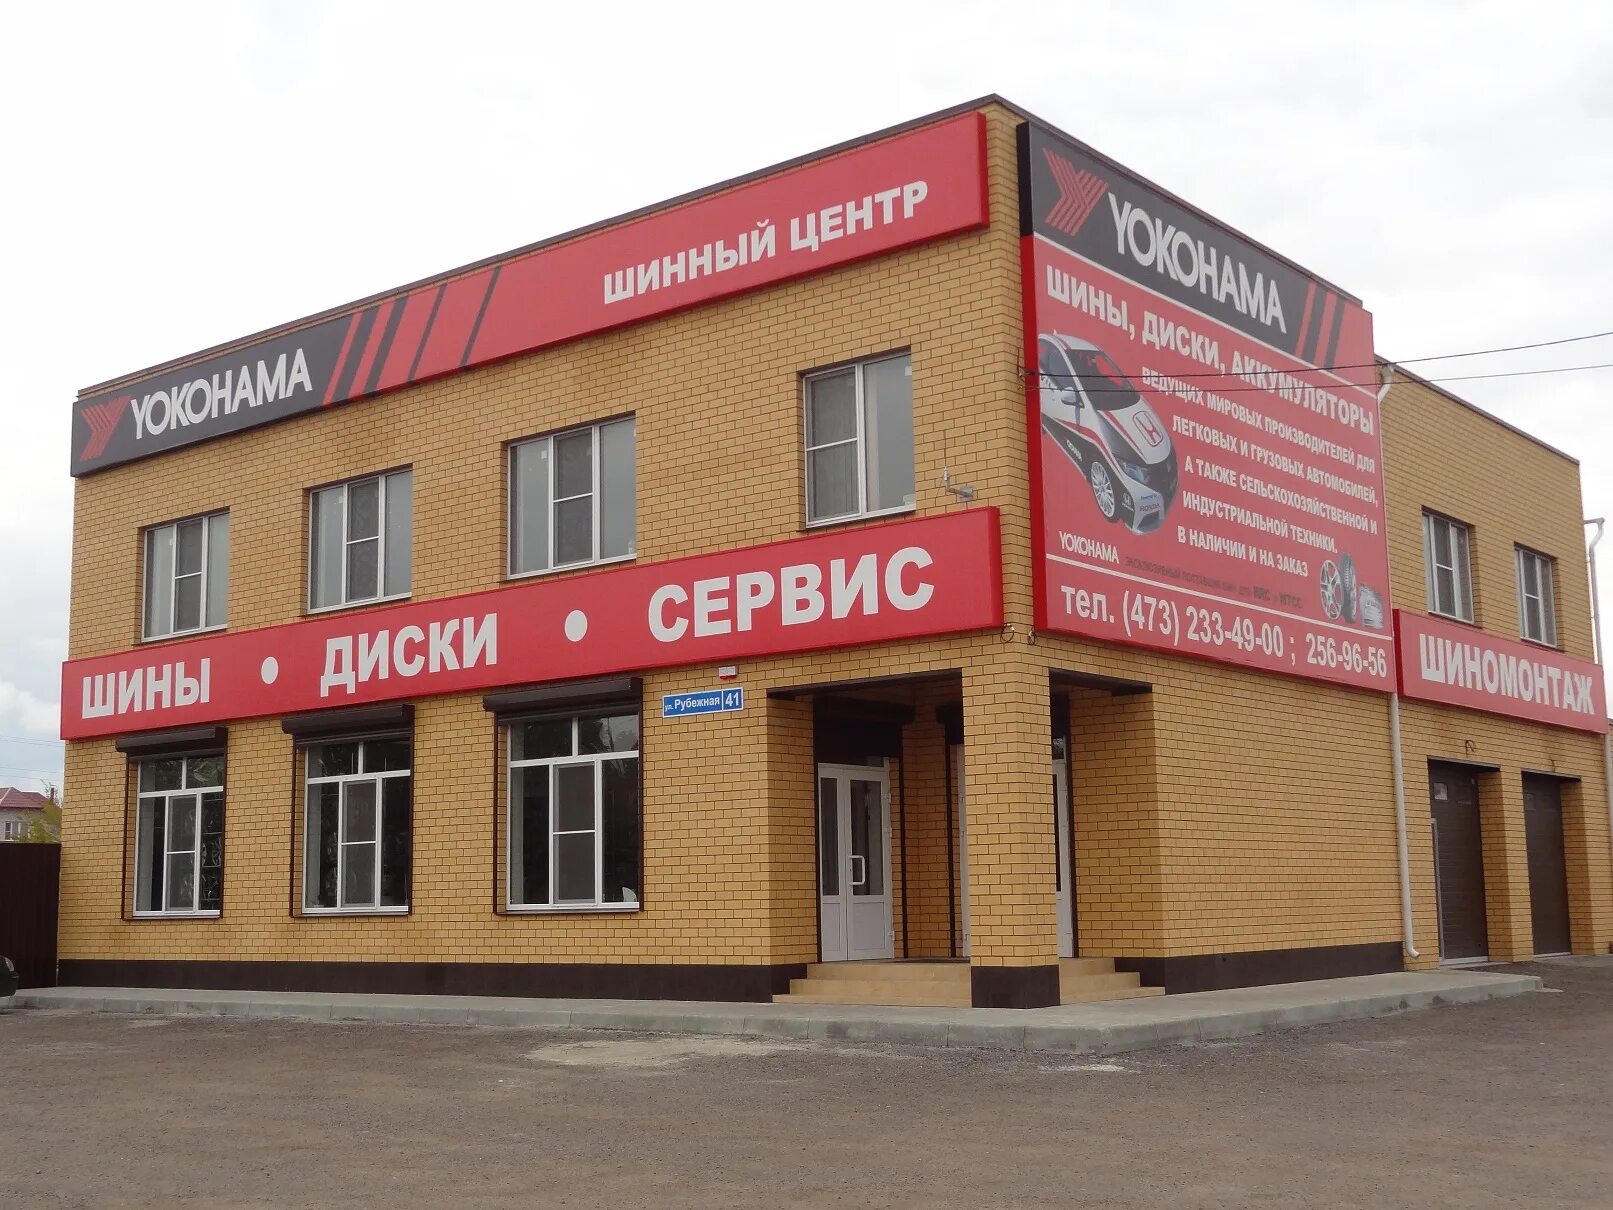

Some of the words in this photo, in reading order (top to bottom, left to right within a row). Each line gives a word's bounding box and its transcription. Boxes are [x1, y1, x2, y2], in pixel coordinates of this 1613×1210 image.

[604, 218, 776, 304] ШИННЫЙ
[790, 180, 929, 252] ЦЕНТР
[1107, 192, 1287, 334] YOKOHAMA
[130, 348, 313, 440] YOKOHAMA
[1046, 264, 1136, 341] ШИНЫ,
[1142, 310, 1226, 374] ДИСКИ,
[1231, 351, 1375, 436] АККУМУЛЯТОРЫ
[1142, 366, 1204, 407] ВЕДУЩИХ
[1207, 392, 1263, 428] МИРОВЫХ
[1264, 416, 1355, 466] ПРОИЗВОДИТЕЛЕЙ
[1356, 454, 1376, 474] ДЛЯ
[1172, 415, 1238, 455] ЛЕГКОВЫХ
[1240, 439, 1248, 457] И
[1251, 445, 1304, 479] ГРУЗОВЫХ
[1306, 466, 1378, 507] АВТОМОБИЛЕЙ,
[1183, 490, 1288, 538] ИНДУСТРИАЛЬНОЙ
[1290, 525, 1338, 554] ТЕХНИКИ.
[1184, 455, 1194, 474] А
[1196, 459, 1237, 487] ТАКЖЕ
[1239, 474, 1369, 533] СЕЛЬСКОХОЗЯЙСТВЕННОЙ
[1370, 520, 1377, 535] И
[1059, 530, 1119, 564] YOKOHAMA
[1177, 525, 1187, 543] В
[1189, 528, 1246, 560] НАЛИЧИИ
[1249, 546, 1257, 563] И
[1259, 549, 1274, 569] НА
[1277, 554, 1308, 577] ЗАКАЗ
[81, 657, 211, 719] ШИНЫ
[320, 613, 498, 697] ДИСКИ
[648, 546, 935, 643] СЕРВИС
[1061, 585, 1115, 623] тел.
[1122, 590, 1180, 646] (473)
[1186, 606, 1283, 657] 233-49-00
[1305, 632, 1387, 678] 256-96-56
[1419, 633, 1595, 715] ШИНОМОНТАЖ
[665, 704, 674, 712] ул.
[674, 697, 719, 711] Рубежная
[725, 692, 739, 707] 41
